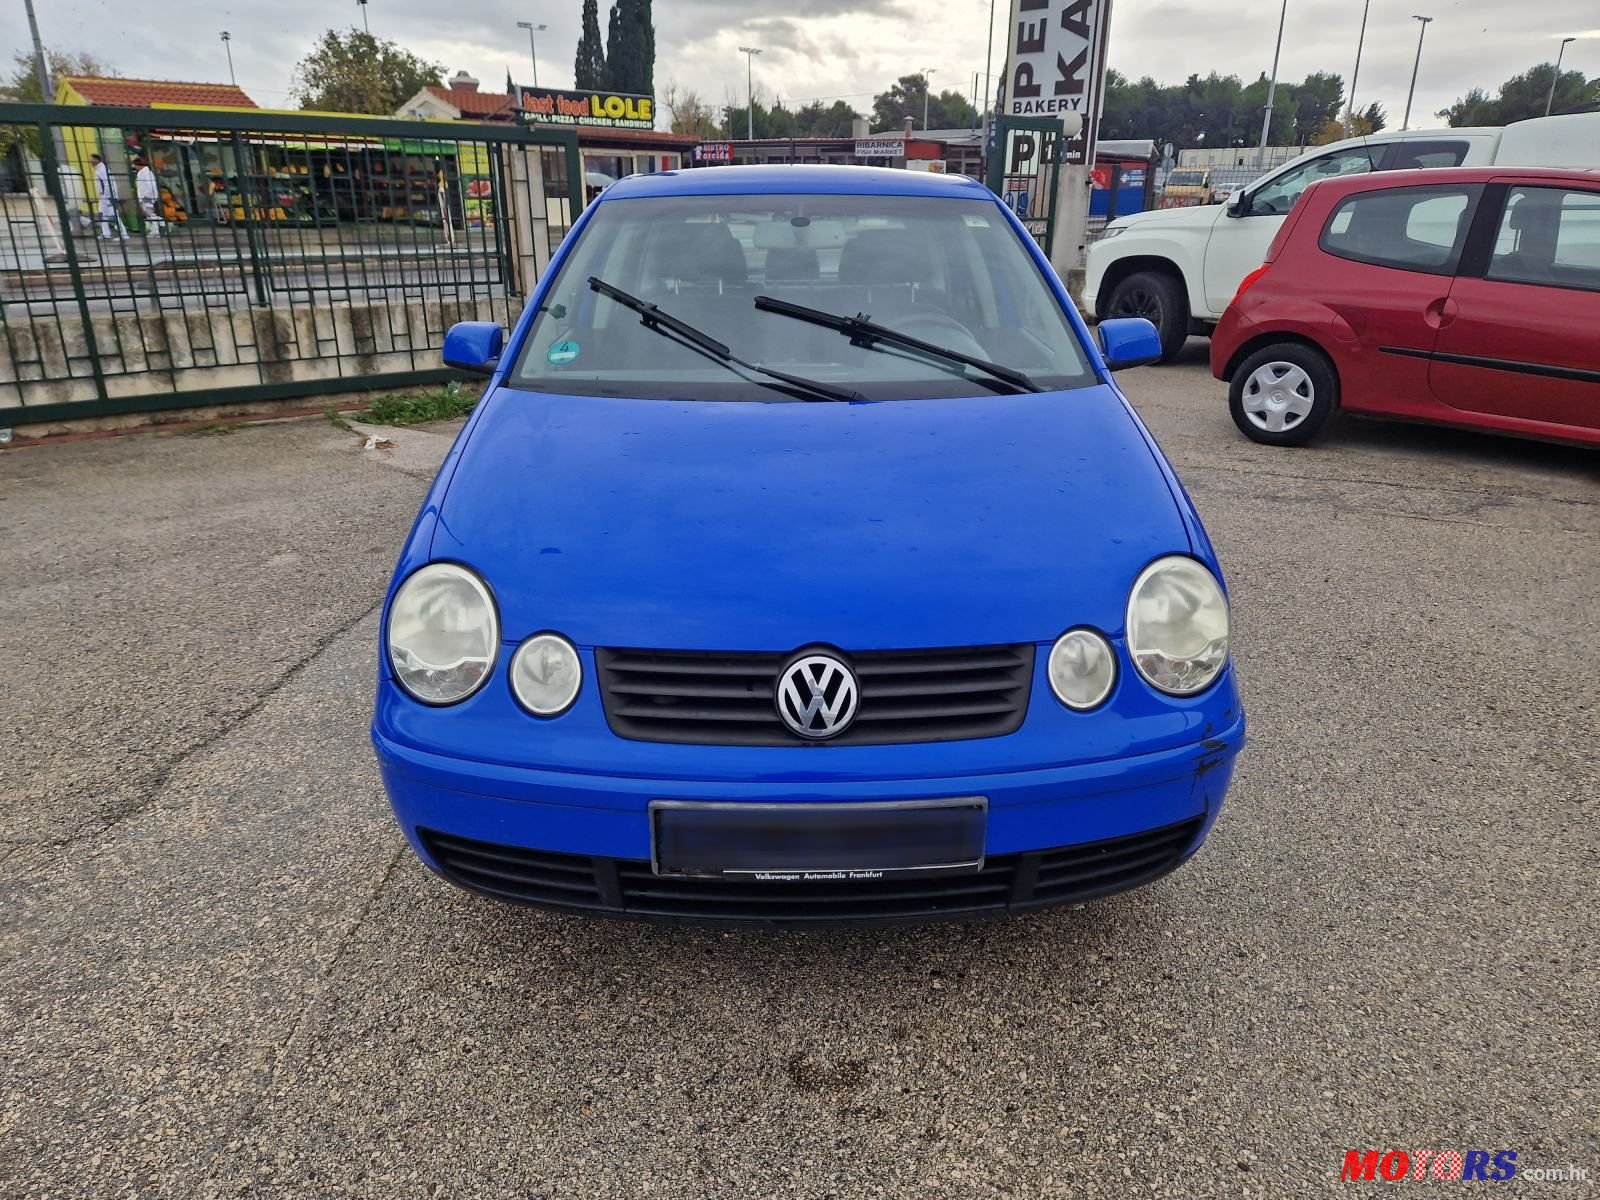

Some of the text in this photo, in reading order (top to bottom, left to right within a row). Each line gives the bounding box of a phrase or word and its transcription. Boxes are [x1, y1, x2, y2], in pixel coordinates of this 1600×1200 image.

[523, 91, 652, 119] fast food LOLE
[1013, 98, 1081, 114] BAKERY
[551, 115, 575, 124] PIZZA
[578, 116, 612, 127] CHICKEN
[614, 118, 652, 128] SANDWICH
[856, 141, 903, 149] RIBARNICA
[559, 341, 569, 353] 4
[755, 871, 883, 881] Volkswagen Automobile Frankfurt
